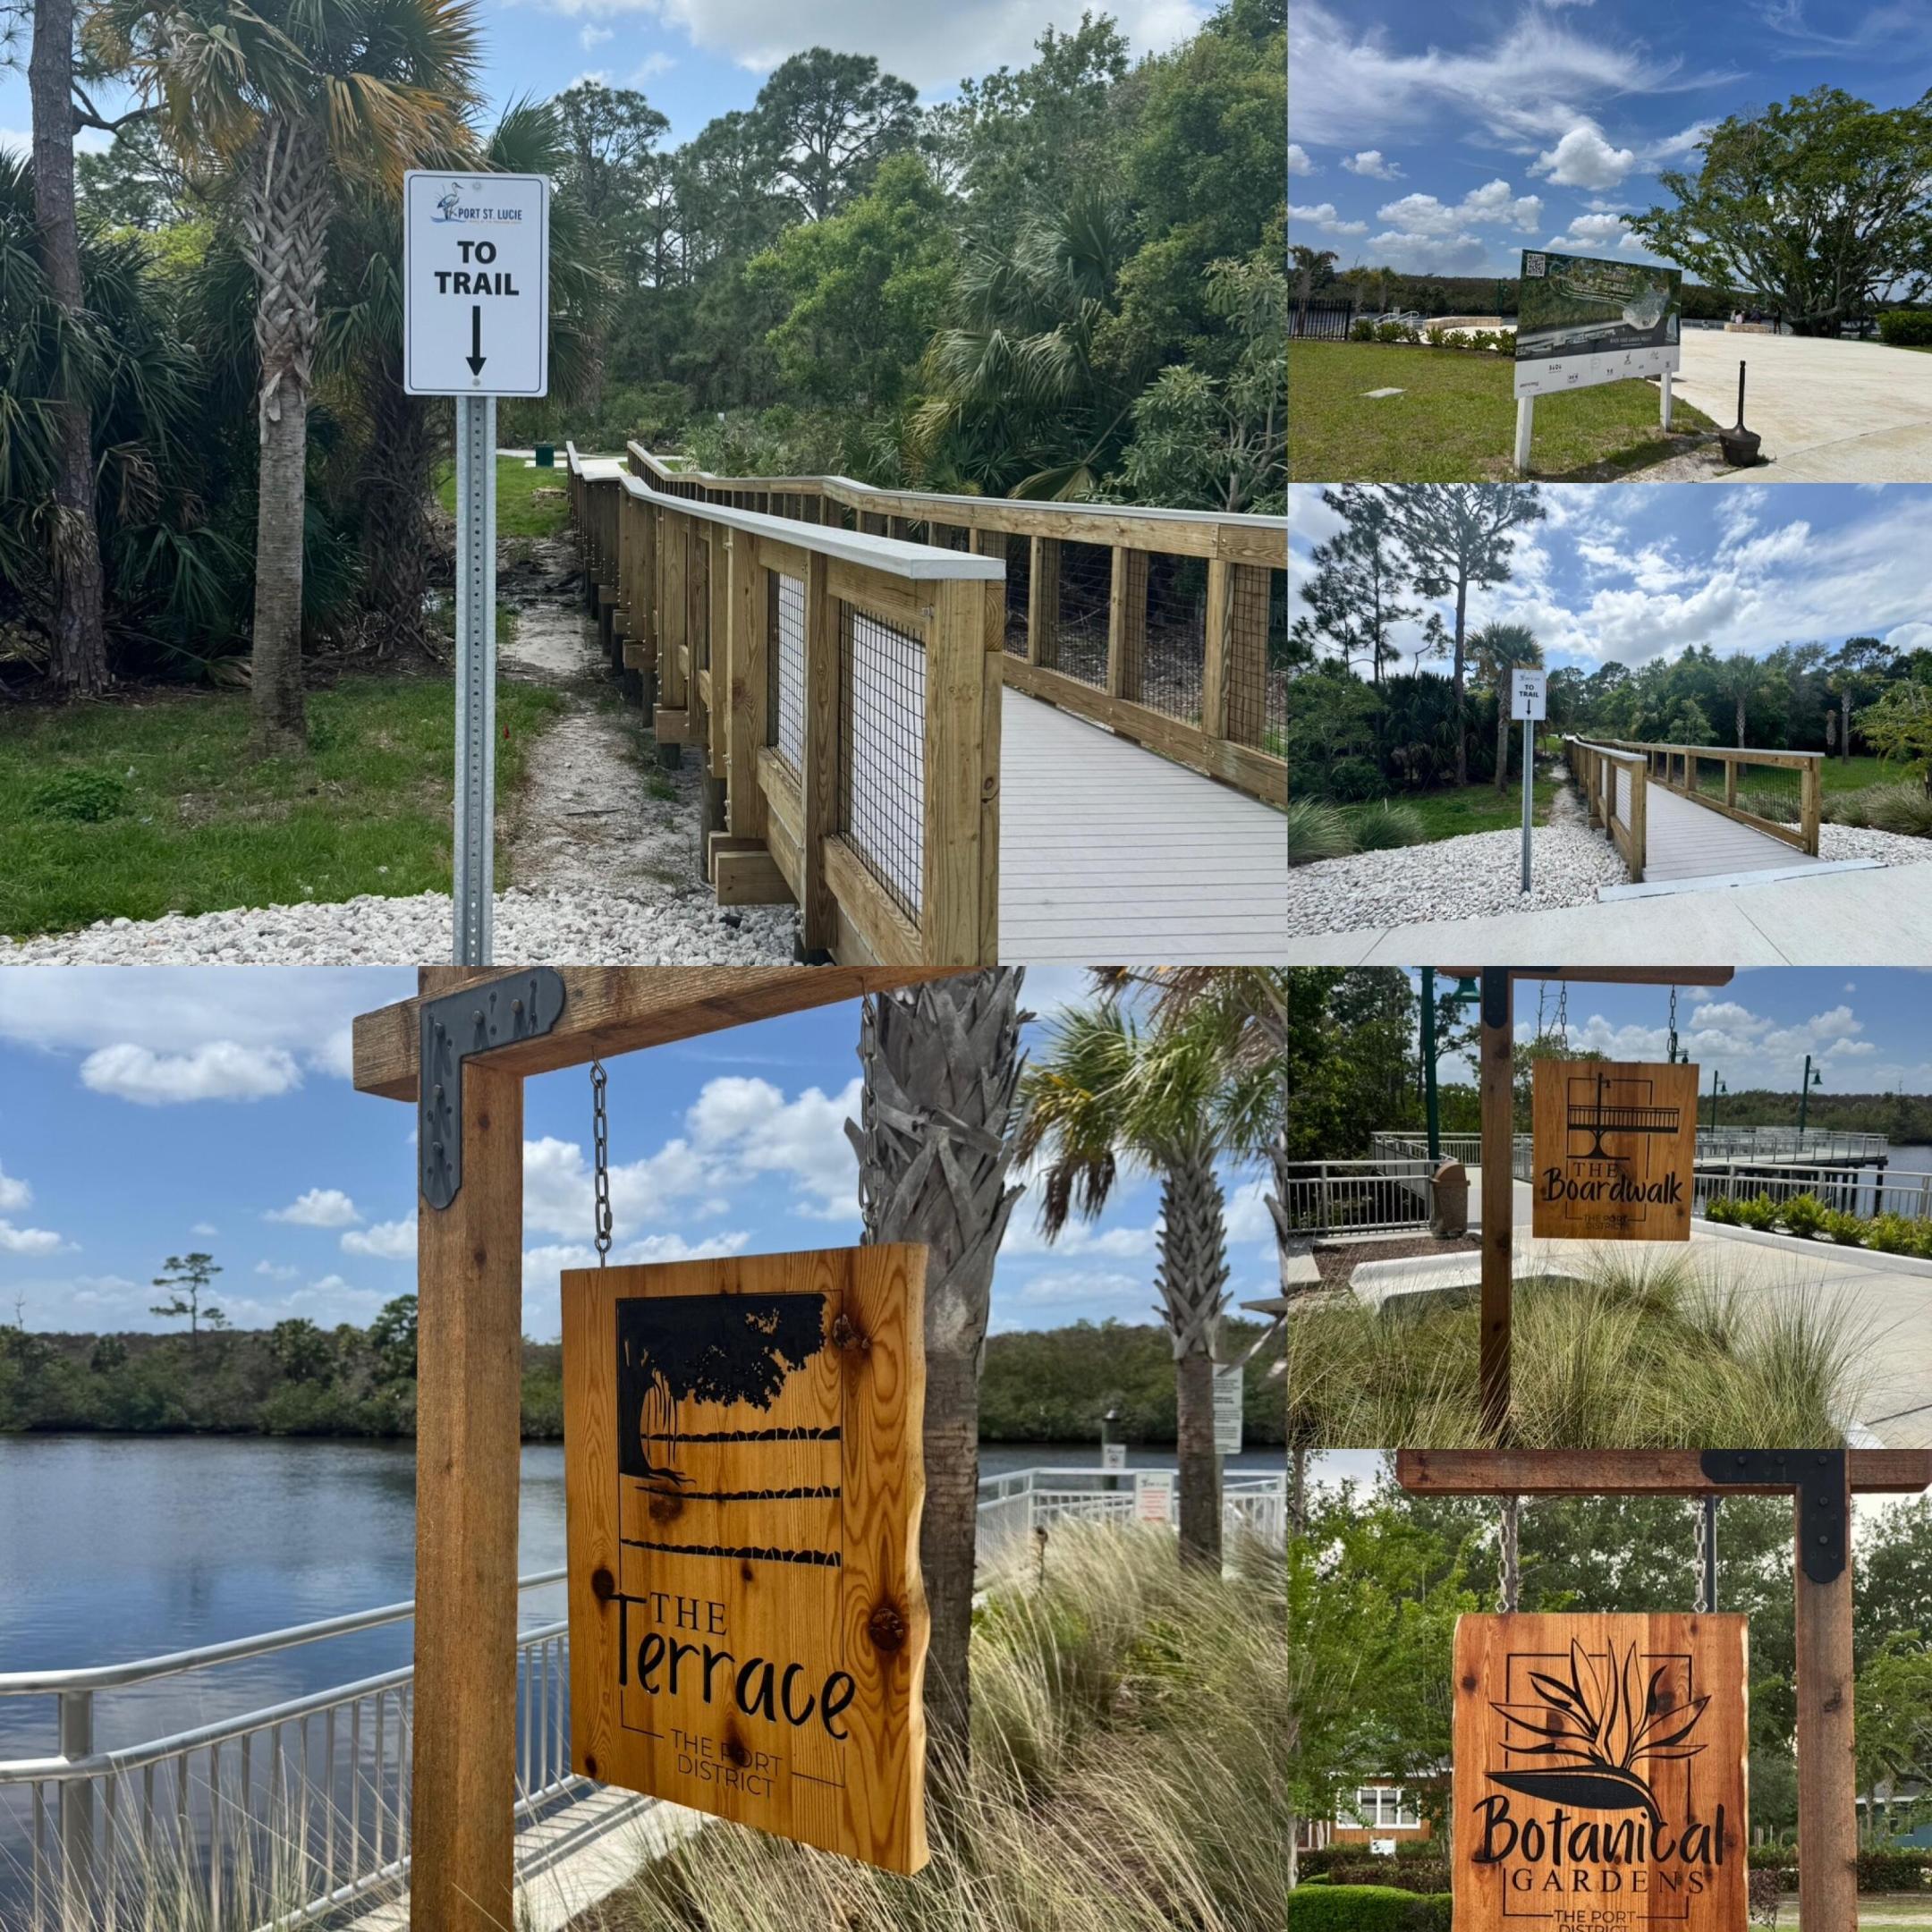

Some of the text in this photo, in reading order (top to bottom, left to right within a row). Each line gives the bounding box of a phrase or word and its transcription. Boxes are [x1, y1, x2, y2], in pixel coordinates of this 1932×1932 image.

[458, 208, 522, 220] PORT ST. LUCIE
[457, 241, 496, 265] TO
[434, 271, 520, 296] TRAIL
[1543, 1167, 1683, 1204] Boardwalk
[1573, 1163, 1618, 1178] THE
[649, 1591, 727, 1636] THE
[603, 1591, 856, 1740] Terrace
[670, 1728, 783, 1776] THE PORT
[678, 1754, 775, 1799] DISTRICT
[1471, 1794, 1725, 1866] Botanical
[1512, 1868, 1704, 1894] GARDENS
[1554, 1910, 1636, 1924] THE PORT
